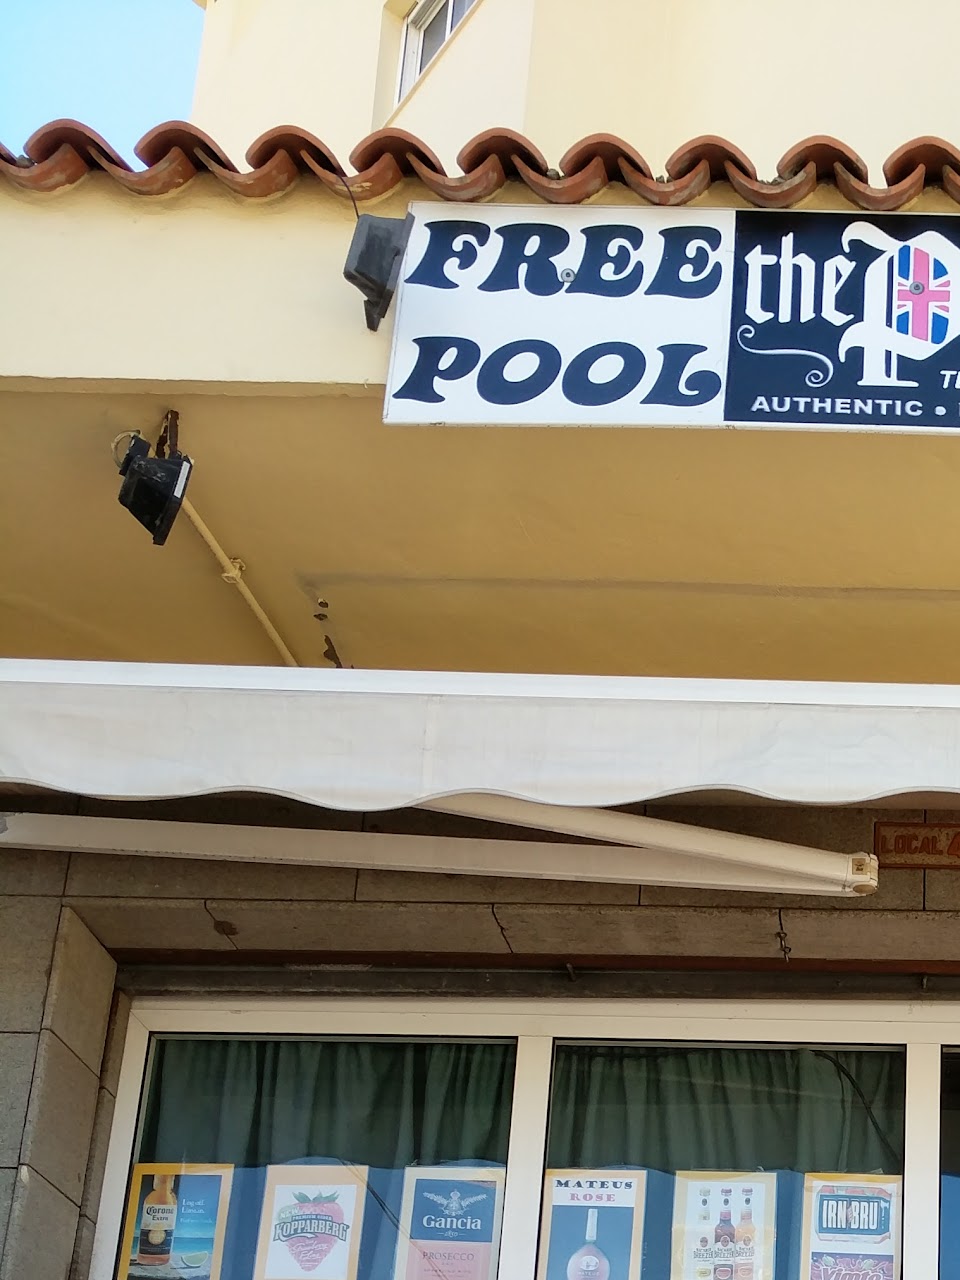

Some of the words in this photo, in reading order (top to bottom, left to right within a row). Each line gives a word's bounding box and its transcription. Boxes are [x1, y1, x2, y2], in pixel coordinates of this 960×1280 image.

[404, 219, 723, 299] FREE
[744, 230, 858, 326] the
[392, 336, 723, 407] POOL
[750, 395, 924, 417] AUTHENTIC
[880, 832, 944, 856] LOCAL
[554, 1179, 633, 1190] MATEUS
[569, 1193, 616, 1202] ROSE
[422, 1215, 482, 1230] Gancia
[822, 1200, 848, 1229] IRN
[850, 1201, 879, 1230] BRU
[273, 1220, 350, 1242] KOPPARBERG
